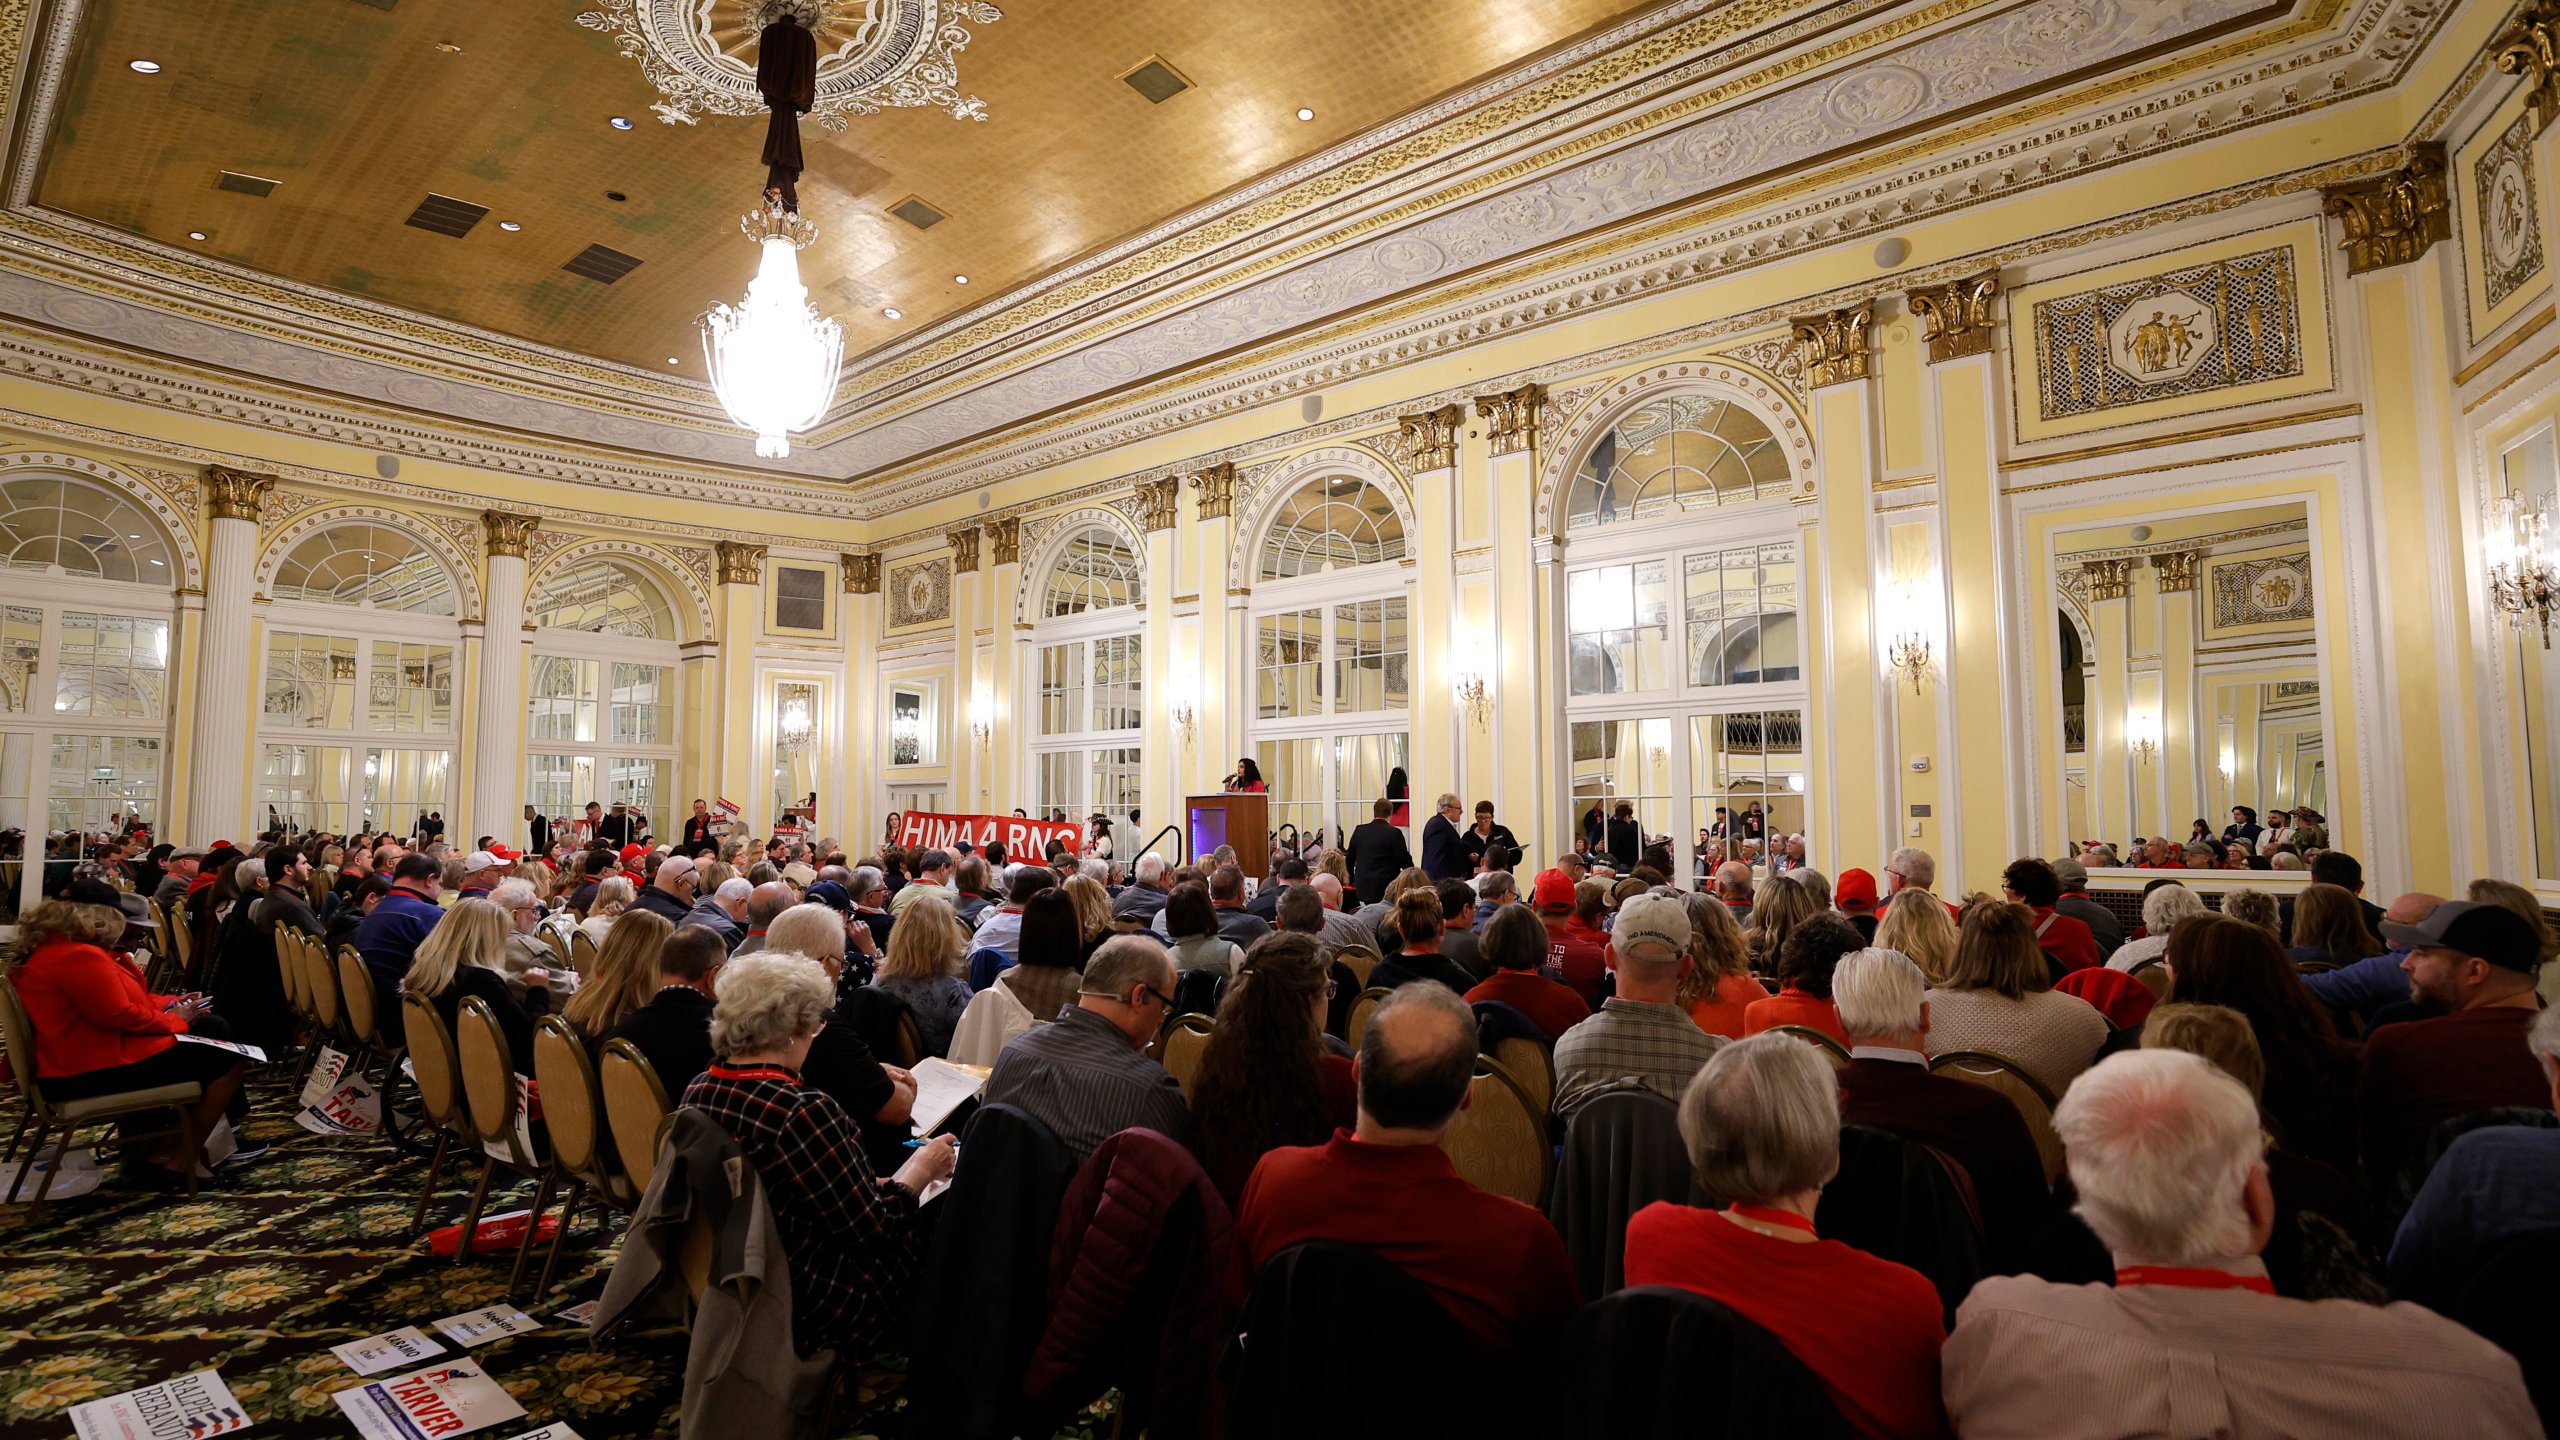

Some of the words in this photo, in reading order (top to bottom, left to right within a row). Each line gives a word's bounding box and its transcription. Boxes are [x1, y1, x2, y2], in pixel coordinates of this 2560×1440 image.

[902, 816, 974, 850] HIMA
[979, 821, 998, 847] 4
[1008, 823, 1077, 861] RNC
[1554, 944, 1566, 954] TO
[1627, 931, 1639, 941] 2ND
[1640, 930, 1678, 947] AMENDMENT
[481, 1310, 517, 1333] Hoekstra
[383, 1333, 421, 1358] KARAMO
[169, 1375, 217, 1417] RALPH
[390, 1376, 464, 1438] TARVER
[132, 1386, 192, 1440] REBANDT
